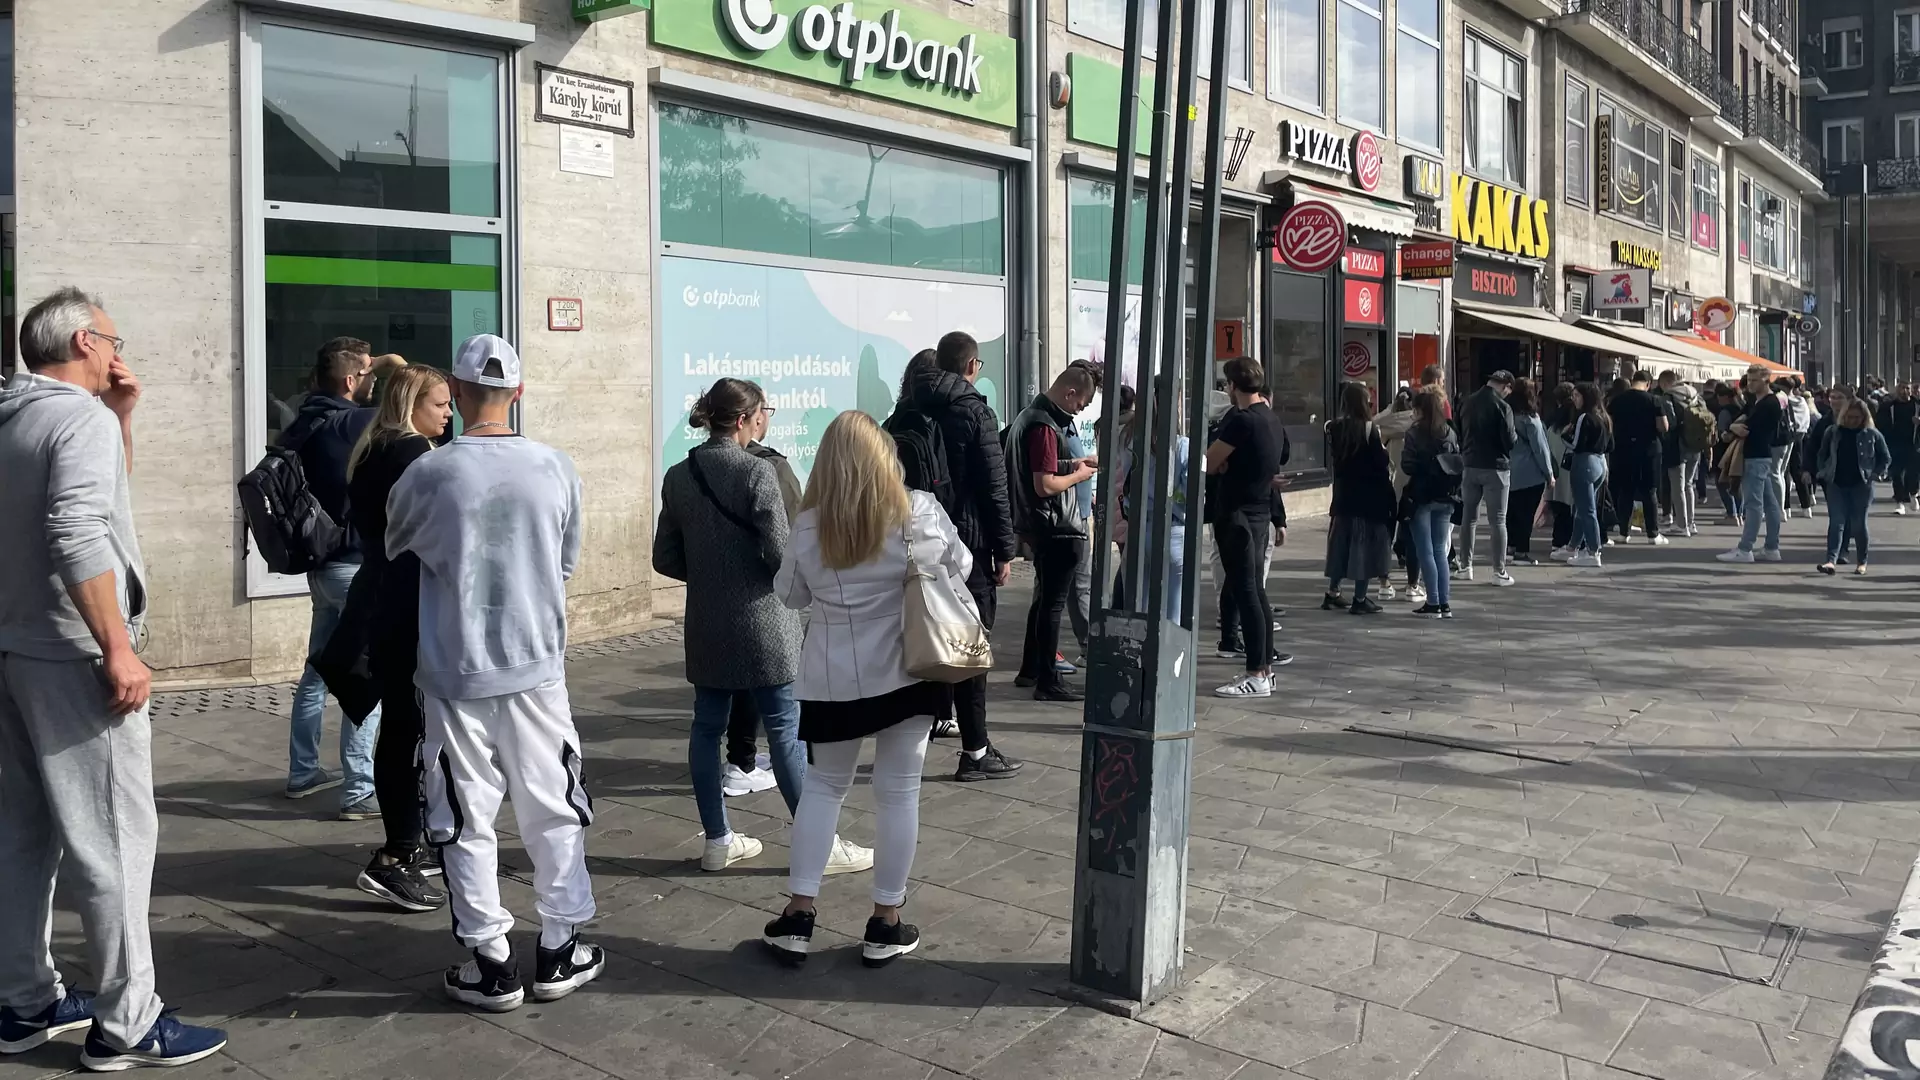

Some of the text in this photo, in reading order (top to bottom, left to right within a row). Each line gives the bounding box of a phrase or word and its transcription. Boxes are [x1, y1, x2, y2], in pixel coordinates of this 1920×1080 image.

[801, 4, 985, 94] otpbank
[549, 85, 587, 114] Károly
[571, 110, 602, 122] 25 17
[1287, 120, 1353, 175] PIZZA
[1600, 119, 1608, 193] MASSAGE
[1295, 214, 1330, 227] PIZZA
[1450, 171, 1550, 259] KAKAS
[1352, 252, 1378, 272] PIZZA
[1403, 248, 1451, 261] change
[1618, 240, 1632, 265] THAI
[1471, 268, 1517, 297] BISZTRÓ
[703, 287, 760, 309] otpbank
[684, 353, 852, 382] Lakásmegoldások
